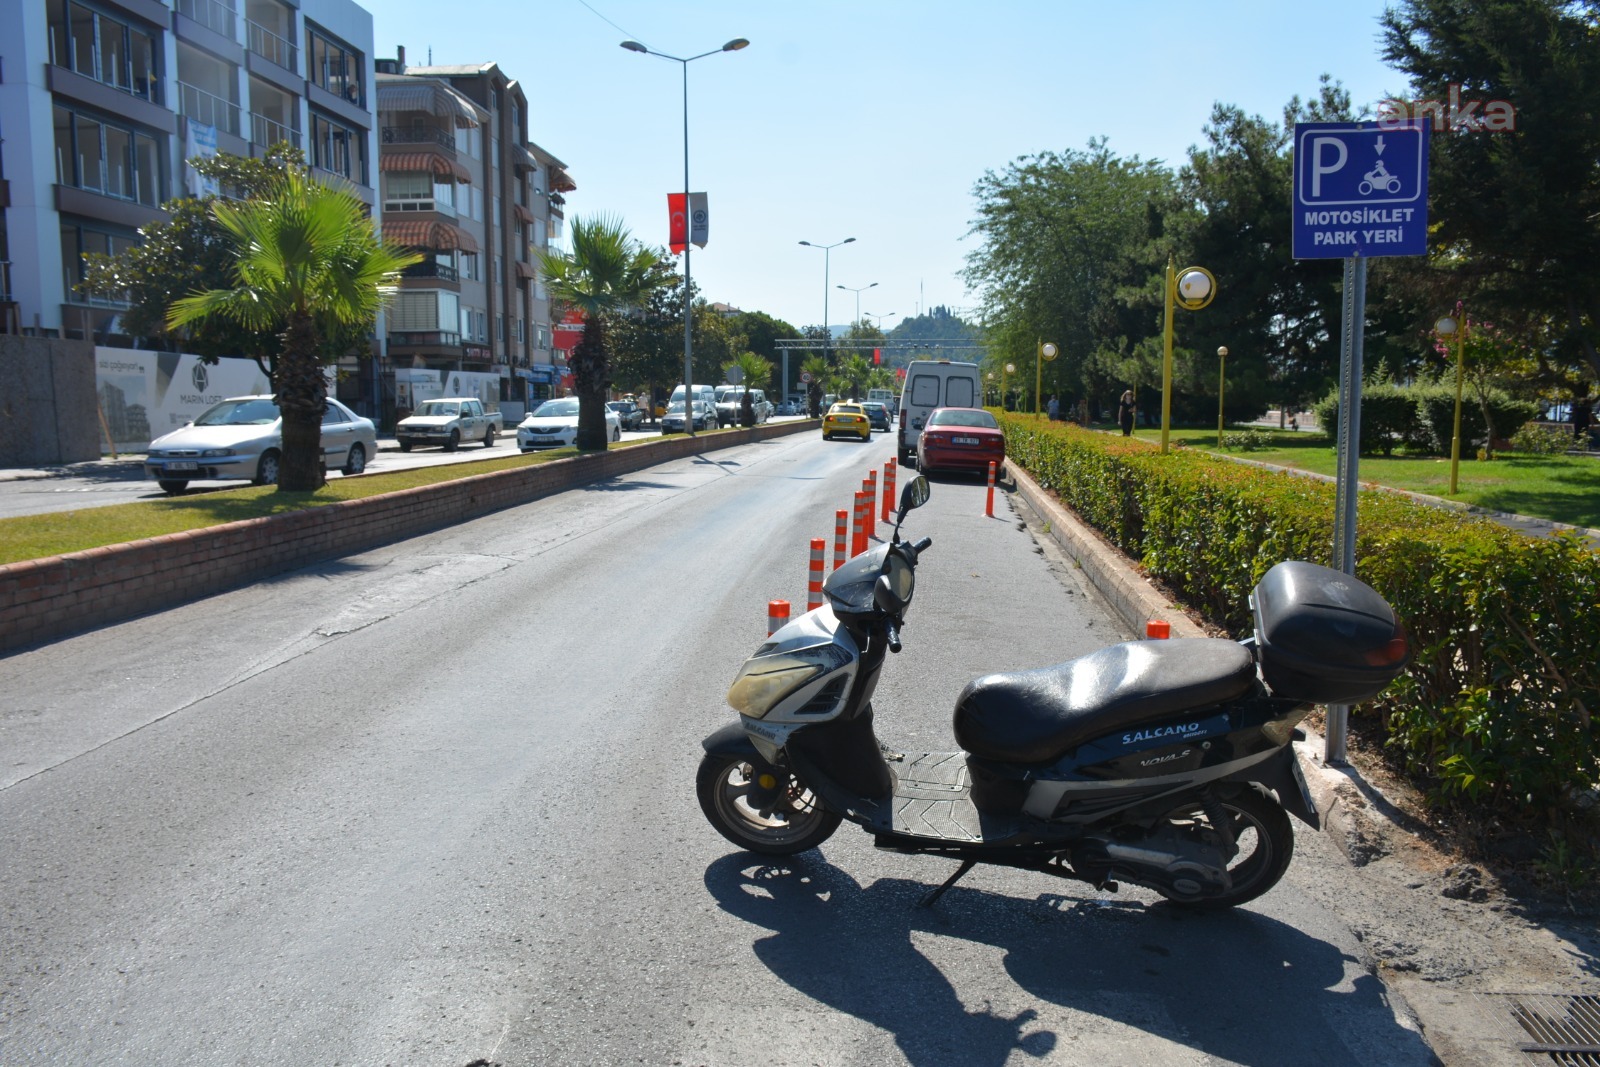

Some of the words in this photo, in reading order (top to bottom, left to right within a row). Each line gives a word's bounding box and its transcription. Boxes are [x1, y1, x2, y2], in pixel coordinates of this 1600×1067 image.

[1312, 137, 1348, 197] P
[1304, 207, 1414, 226] MOTOSİKLET
[1314, 230, 1357, 245] PARK
[1362, 226, 1403, 244] YERİ
[180, 395, 204, 405] MARIN
[1122, 722, 1200, 745] SALCANO
